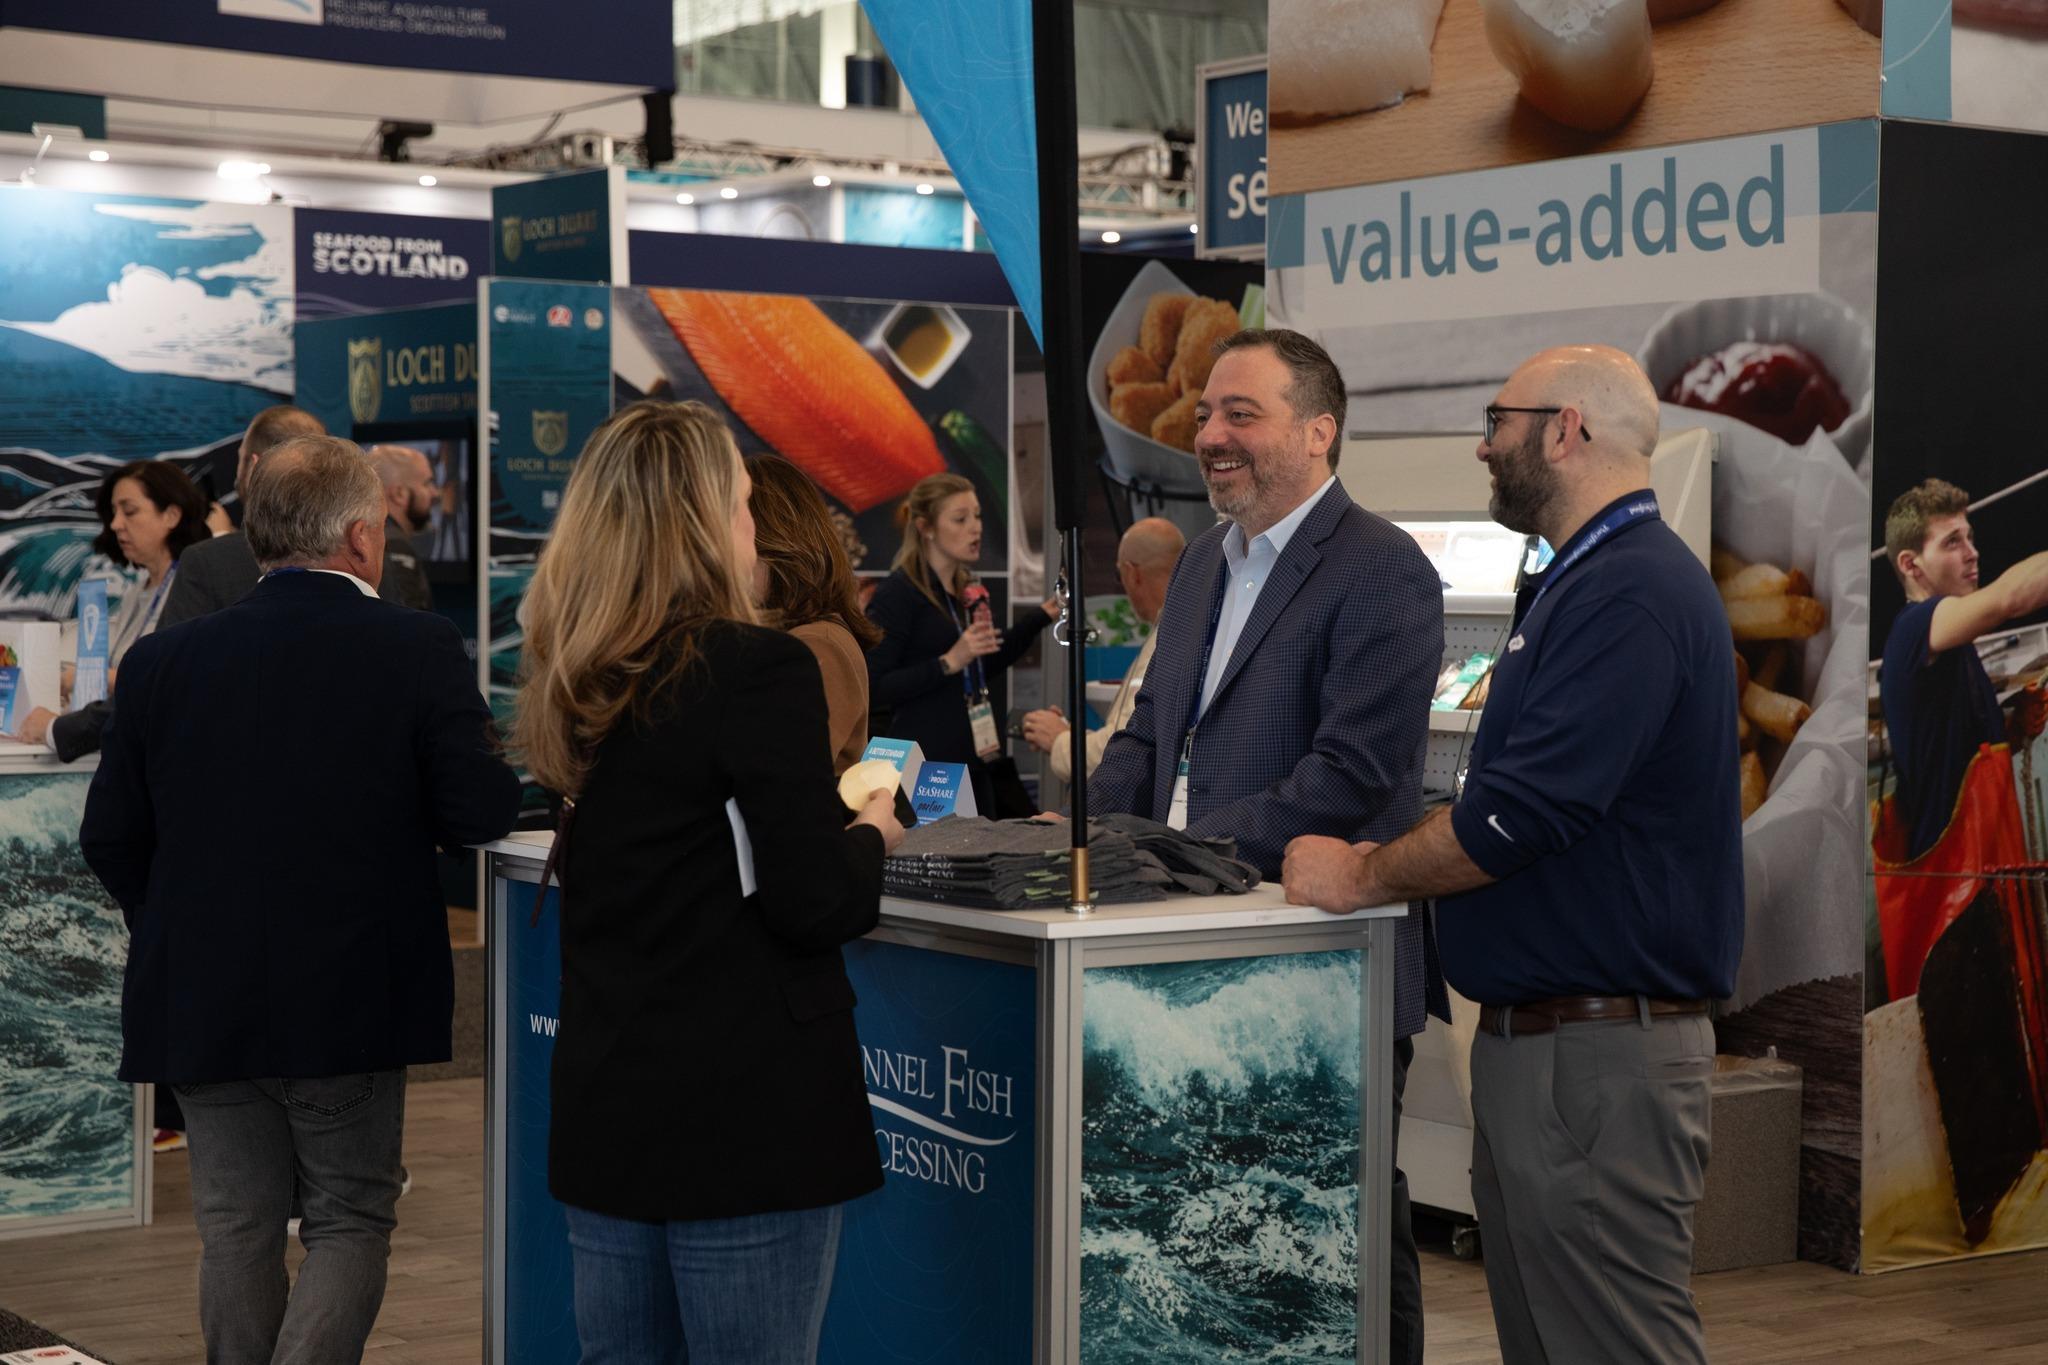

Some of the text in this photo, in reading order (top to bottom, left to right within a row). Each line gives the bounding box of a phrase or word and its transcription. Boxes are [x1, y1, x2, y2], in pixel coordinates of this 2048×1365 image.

[1226, 102, 1264, 139] We
[1321, 143, 1785, 285] value-added
[313, 232, 443, 256] SEAFOOD FROM
[313, 248, 469, 280] SCOTLAND
[386, 344, 445, 388] LOCH
